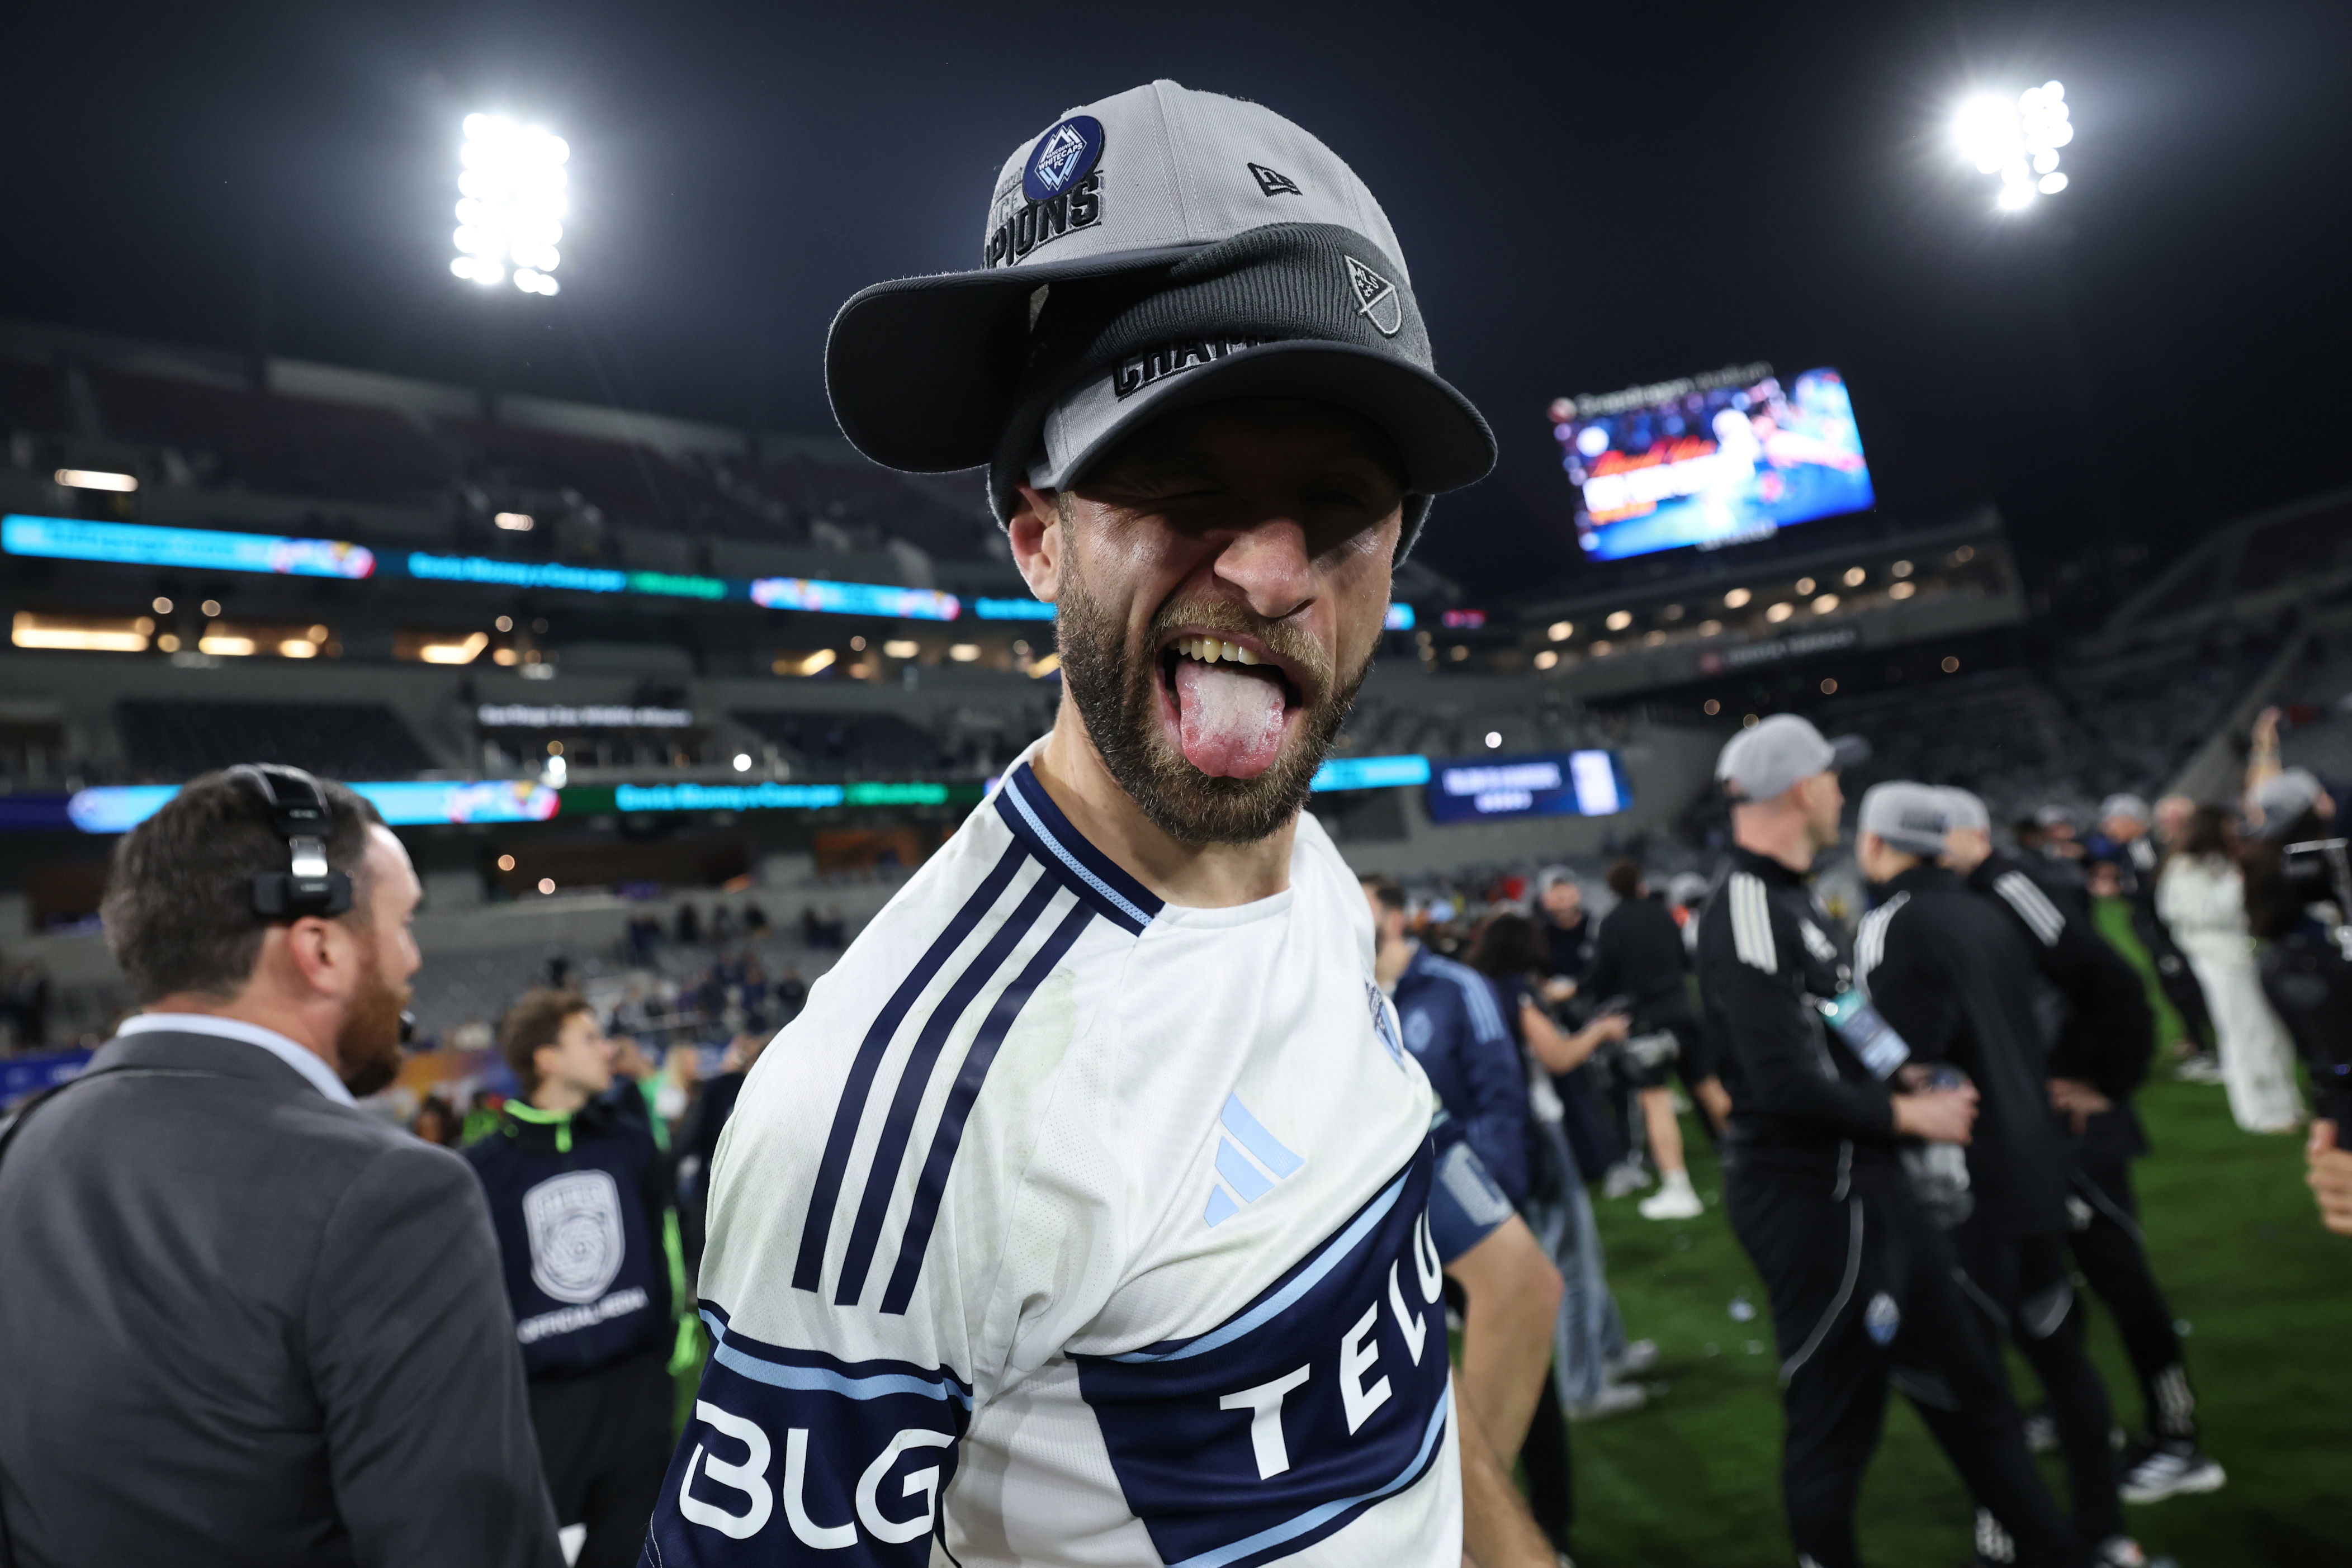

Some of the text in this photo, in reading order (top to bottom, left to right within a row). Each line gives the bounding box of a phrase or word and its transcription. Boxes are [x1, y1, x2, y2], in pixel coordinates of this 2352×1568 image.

[1039, 142, 1083, 170] WHITECAPS
[1047, 141, 1075, 159] VANCOUVER
[1054, 158, 1064, 169] FC
[1350, 263, 1379, 290] MLS
[679, 1399, 955, 1550] BLG
